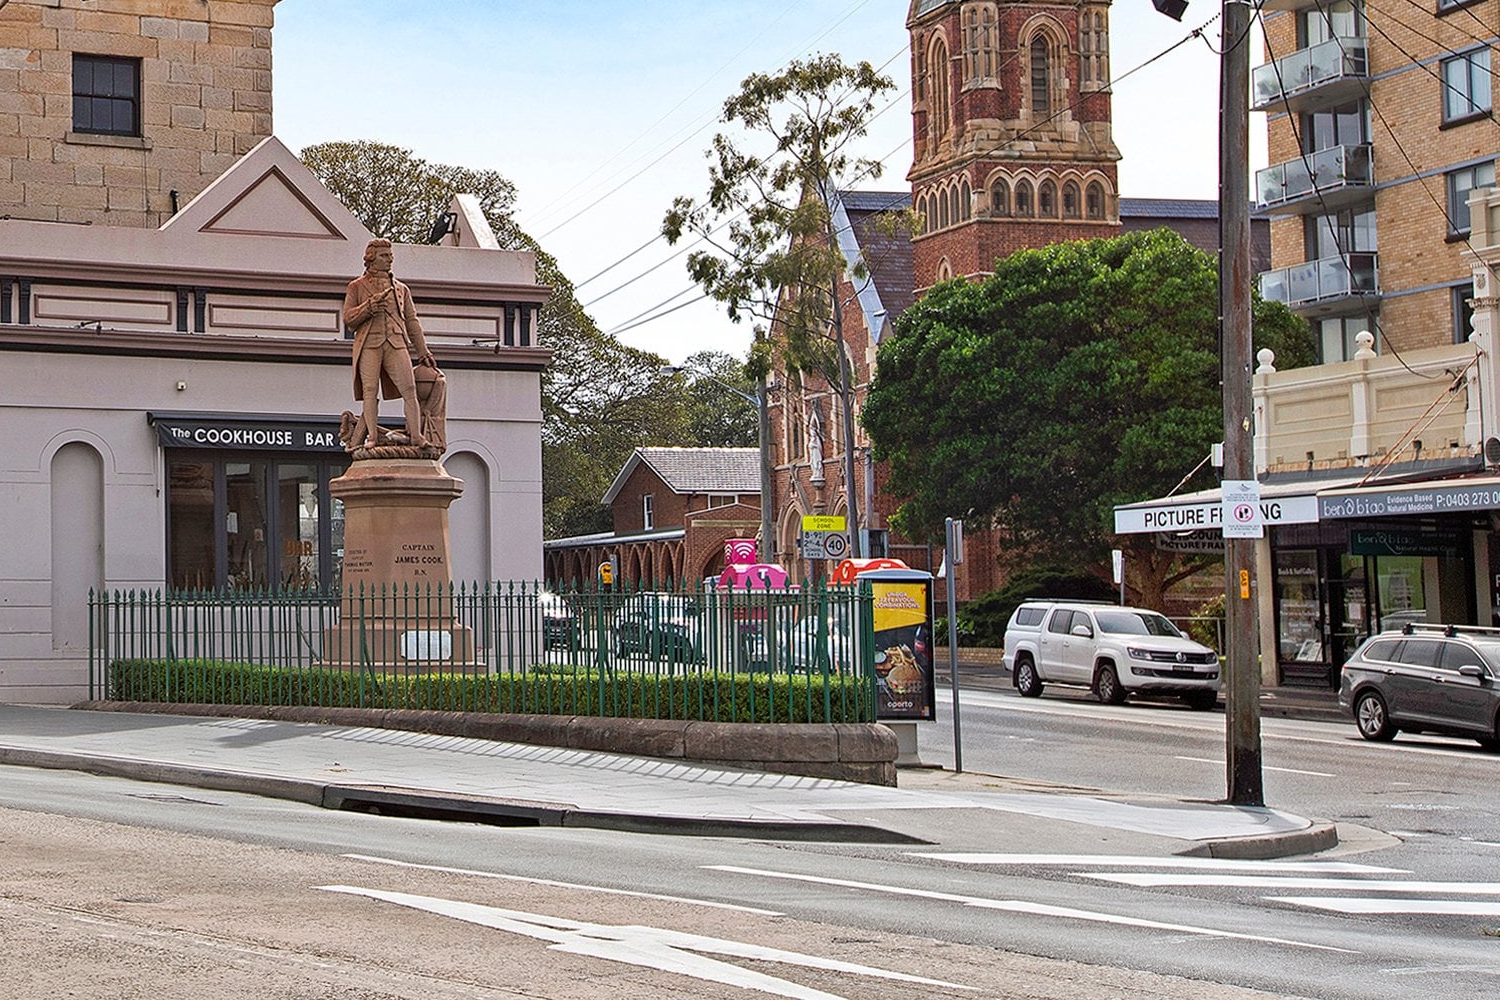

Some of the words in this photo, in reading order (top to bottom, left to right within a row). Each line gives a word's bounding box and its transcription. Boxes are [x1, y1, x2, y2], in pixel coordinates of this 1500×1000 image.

[170, 427, 191, 438] The
[194, 428, 292, 445] COOKHOUSE
[305, 432, 334, 446] BAR
[1387, 494, 1413, 504] Evidence
[1414, 493, 1433, 502] Based
[1472, 492, 1490, 505] 273
[1387, 503, 1407, 512] Natural
[1408, 502, 1434, 511] Medicine
[1144, 508, 1205, 527] PICTURE
[284, 540, 313, 558] BAR
[828, 540, 843, 551] 40
[395, 556, 420, 564] JAMES
[887, 701, 914, 709] oporto
